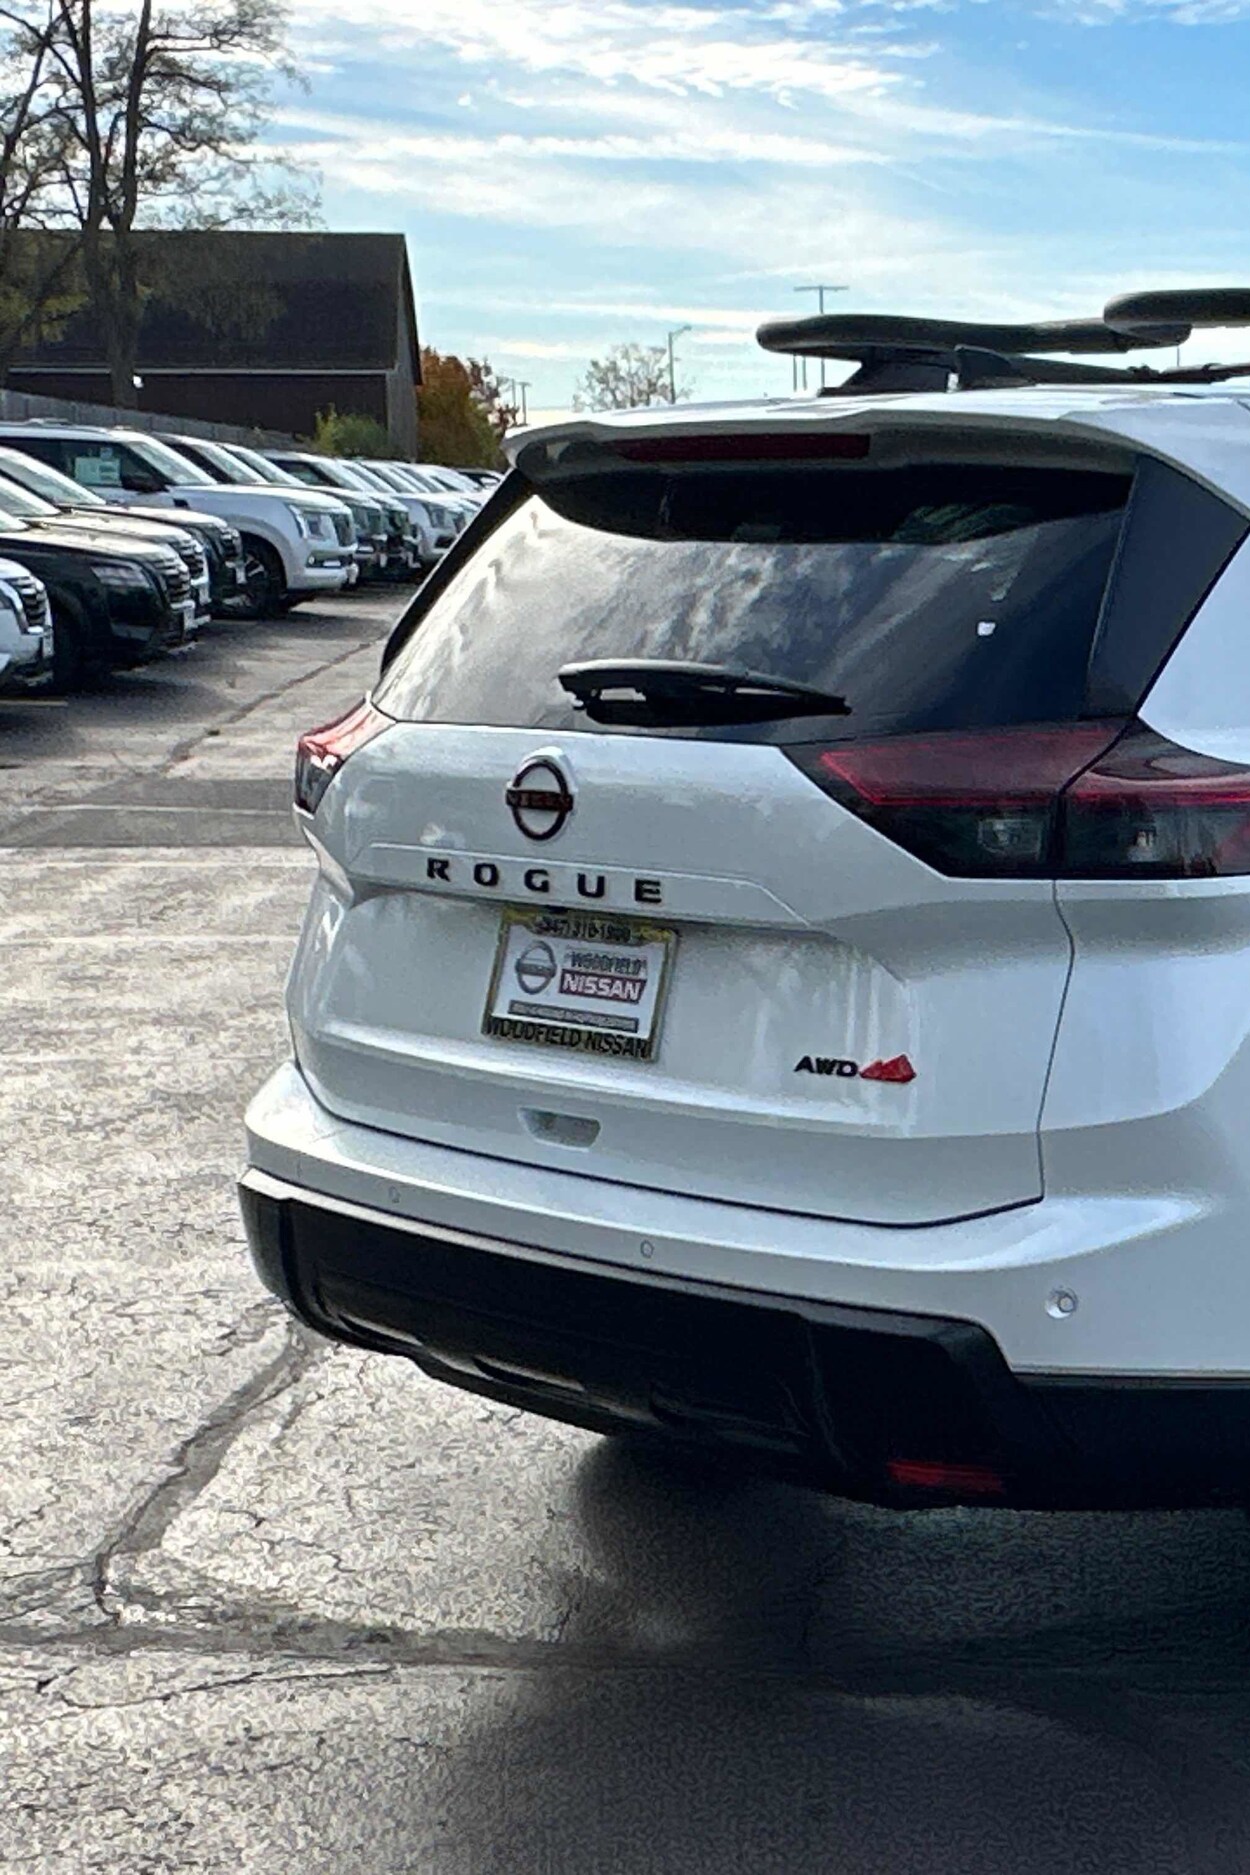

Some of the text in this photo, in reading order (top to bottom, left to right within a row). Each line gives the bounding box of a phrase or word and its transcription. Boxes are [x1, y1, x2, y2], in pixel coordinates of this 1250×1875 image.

[427, 857, 662, 904] ROGUE
[563, 972, 641, 1001] NISSAN
[584, 1030, 649, 1058] NISSAN
[794, 1055, 859, 1078] AWD
